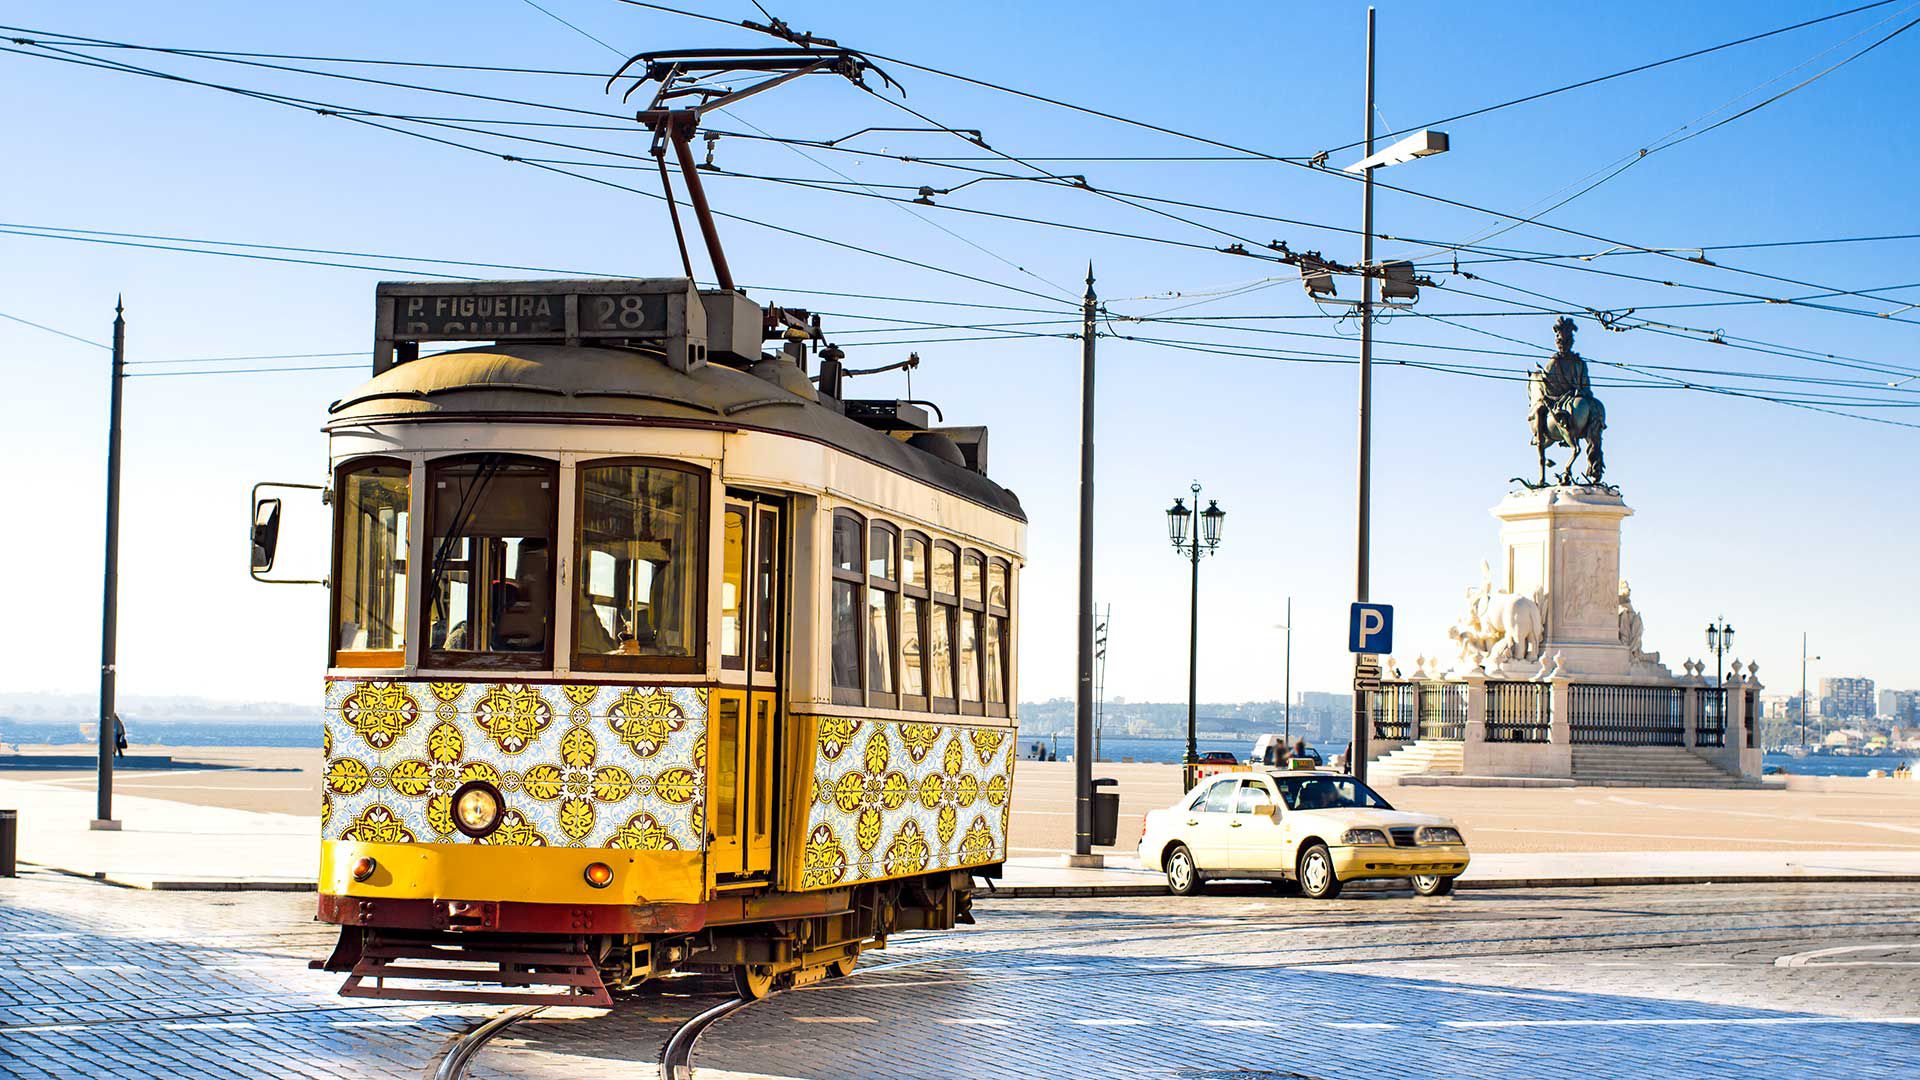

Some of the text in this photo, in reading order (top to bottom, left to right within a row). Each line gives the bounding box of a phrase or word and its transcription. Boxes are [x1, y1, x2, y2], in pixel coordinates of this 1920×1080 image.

[435, 296, 552, 317] FIGUEIRA
[597, 295, 645, 329] 28
[1359, 608, 1384, 648] P
